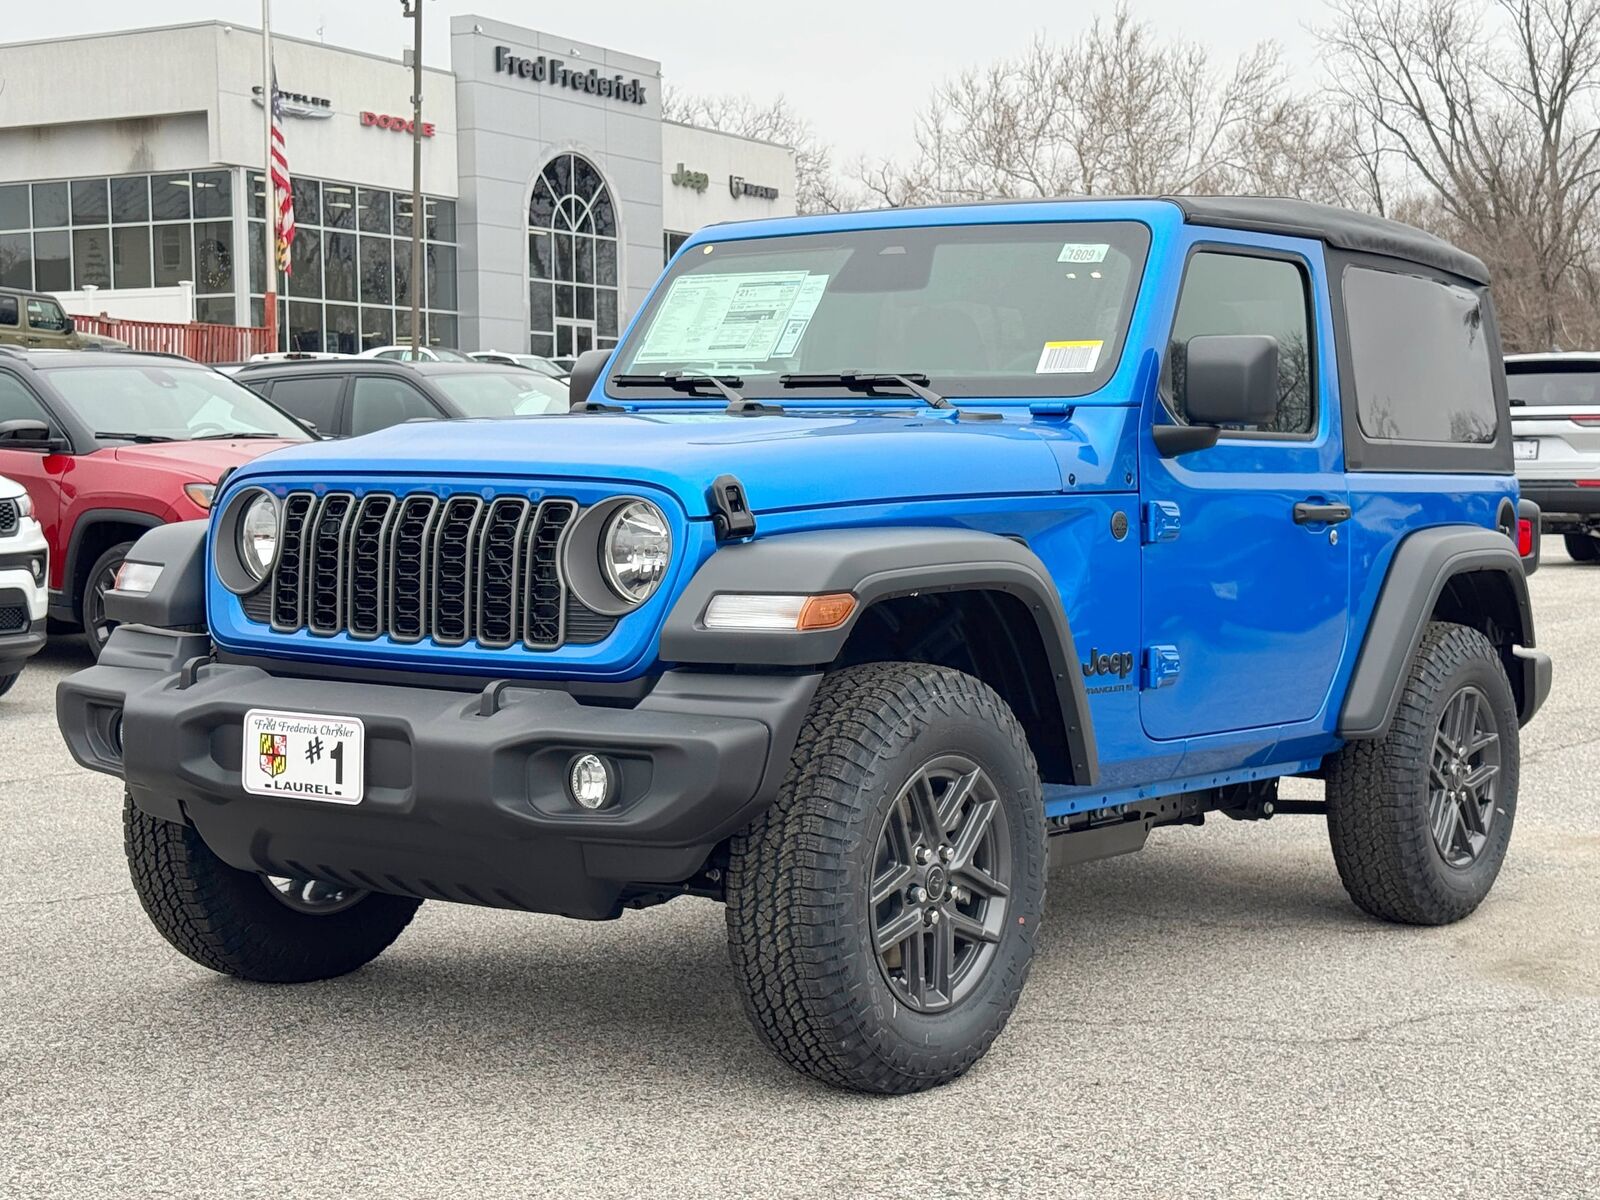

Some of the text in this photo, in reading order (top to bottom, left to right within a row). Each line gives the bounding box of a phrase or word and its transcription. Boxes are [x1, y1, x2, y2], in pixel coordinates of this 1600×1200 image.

[495, 46, 647, 105] Fred Frederick
[252, 83, 331, 107] CYSLER
[671, 162, 709, 194] Jeep
[744, 183, 779, 200] RAM
[1069, 249, 1095, 260] 1809
[1082, 647, 1133, 679] Jeep
[254, 717, 354, 738] Fred Frederick Chrysler
